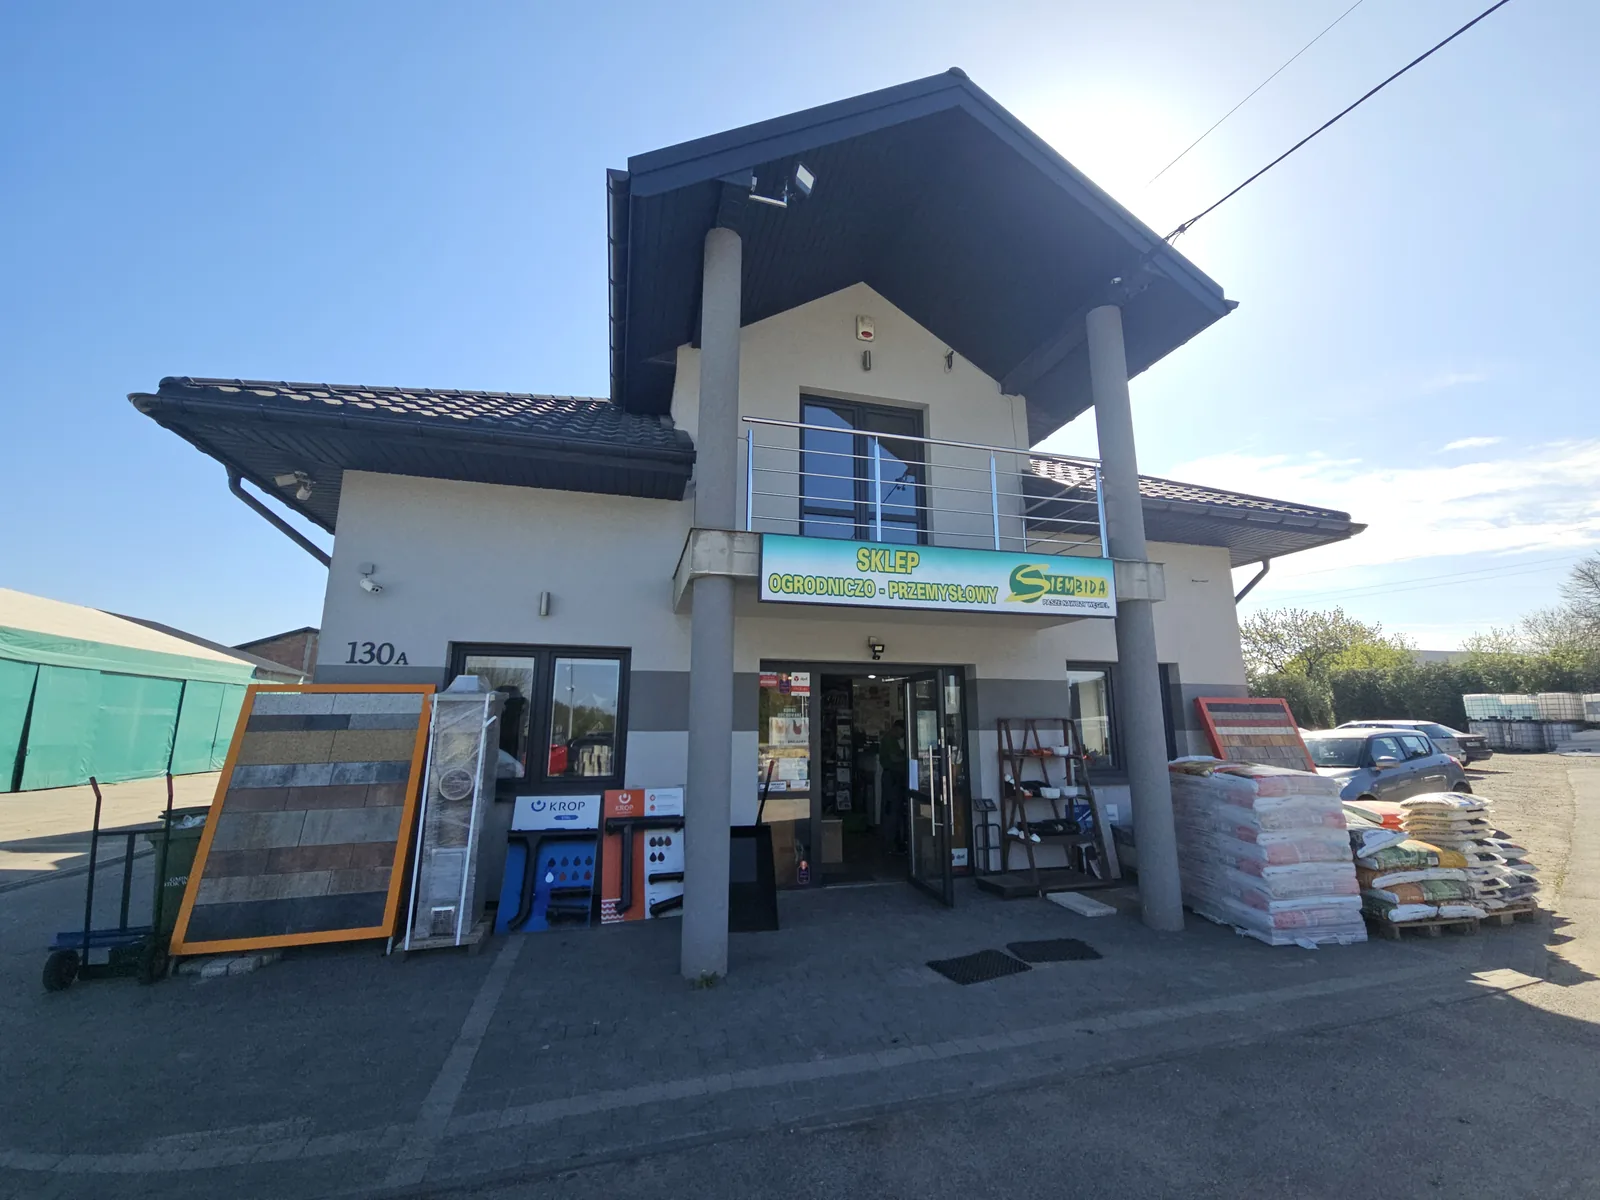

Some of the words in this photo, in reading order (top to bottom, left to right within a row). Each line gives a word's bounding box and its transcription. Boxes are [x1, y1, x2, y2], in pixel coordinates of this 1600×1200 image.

[856, 546, 920, 574] SKLEP
[768, 573, 876, 598] OGRODNICZO
[888, 580, 999, 604] PRZEMYSŁOWY
[1004, 563, 1106, 603] SIEMBIDA
[345, 641, 409, 666] 130A
[549, 801, 586, 812] KROP
